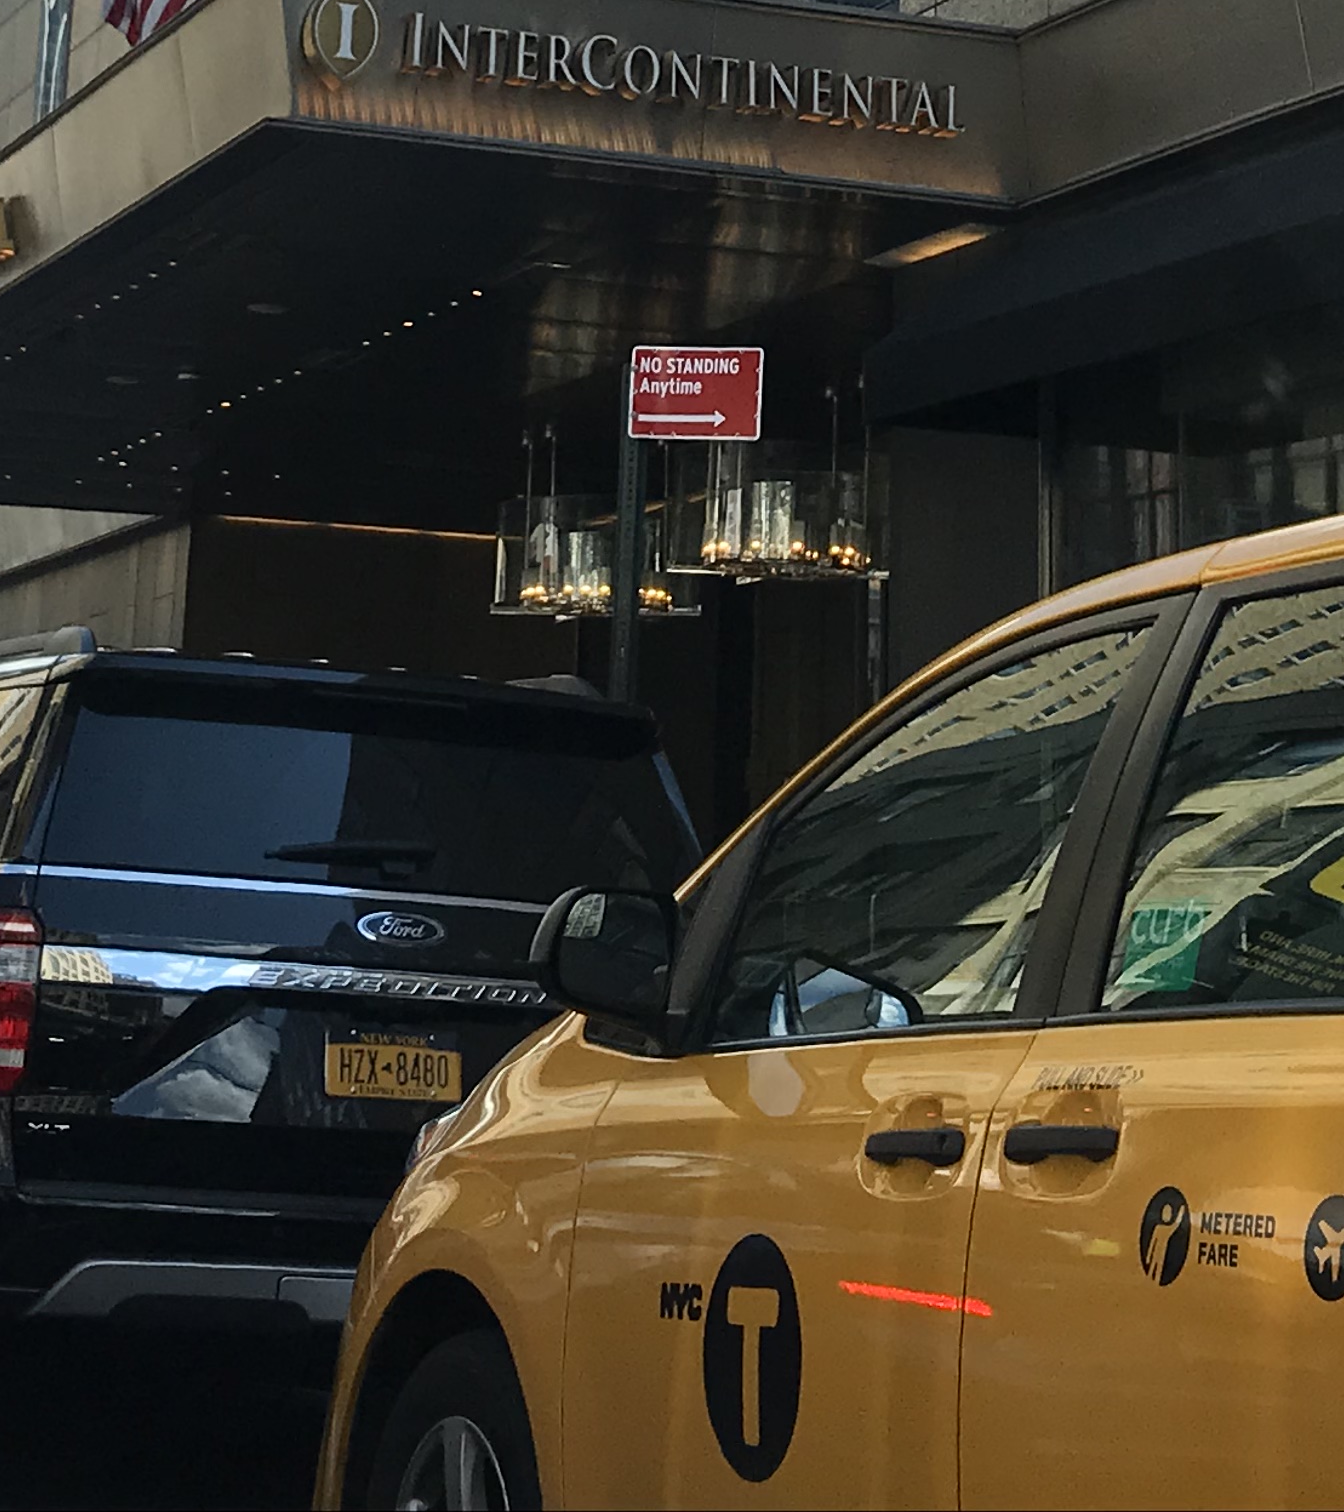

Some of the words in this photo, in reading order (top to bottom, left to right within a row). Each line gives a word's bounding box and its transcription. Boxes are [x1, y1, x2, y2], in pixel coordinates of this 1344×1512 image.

[639, 357, 663, 375] NO
[666, 357, 741, 376] STANDING
[639, 377, 703, 400] Anytime
[378, 915, 428, 939] Ford
[247, 966, 548, 1006] EXPEDITION
[359, 1032, 392, 1045] NEW
[394, 1034, 429, 1046] YORK
[339, 1047, 379, 1085] HZX
[395, 1051, 450, 1089] 8480
[1199, 1213, 1277, 1240] METERED
[1196, 1241, 1240, 1268] FARE
[659, 1282, 704, 1322] NYC
[726, 1285, 781, 1449] T
